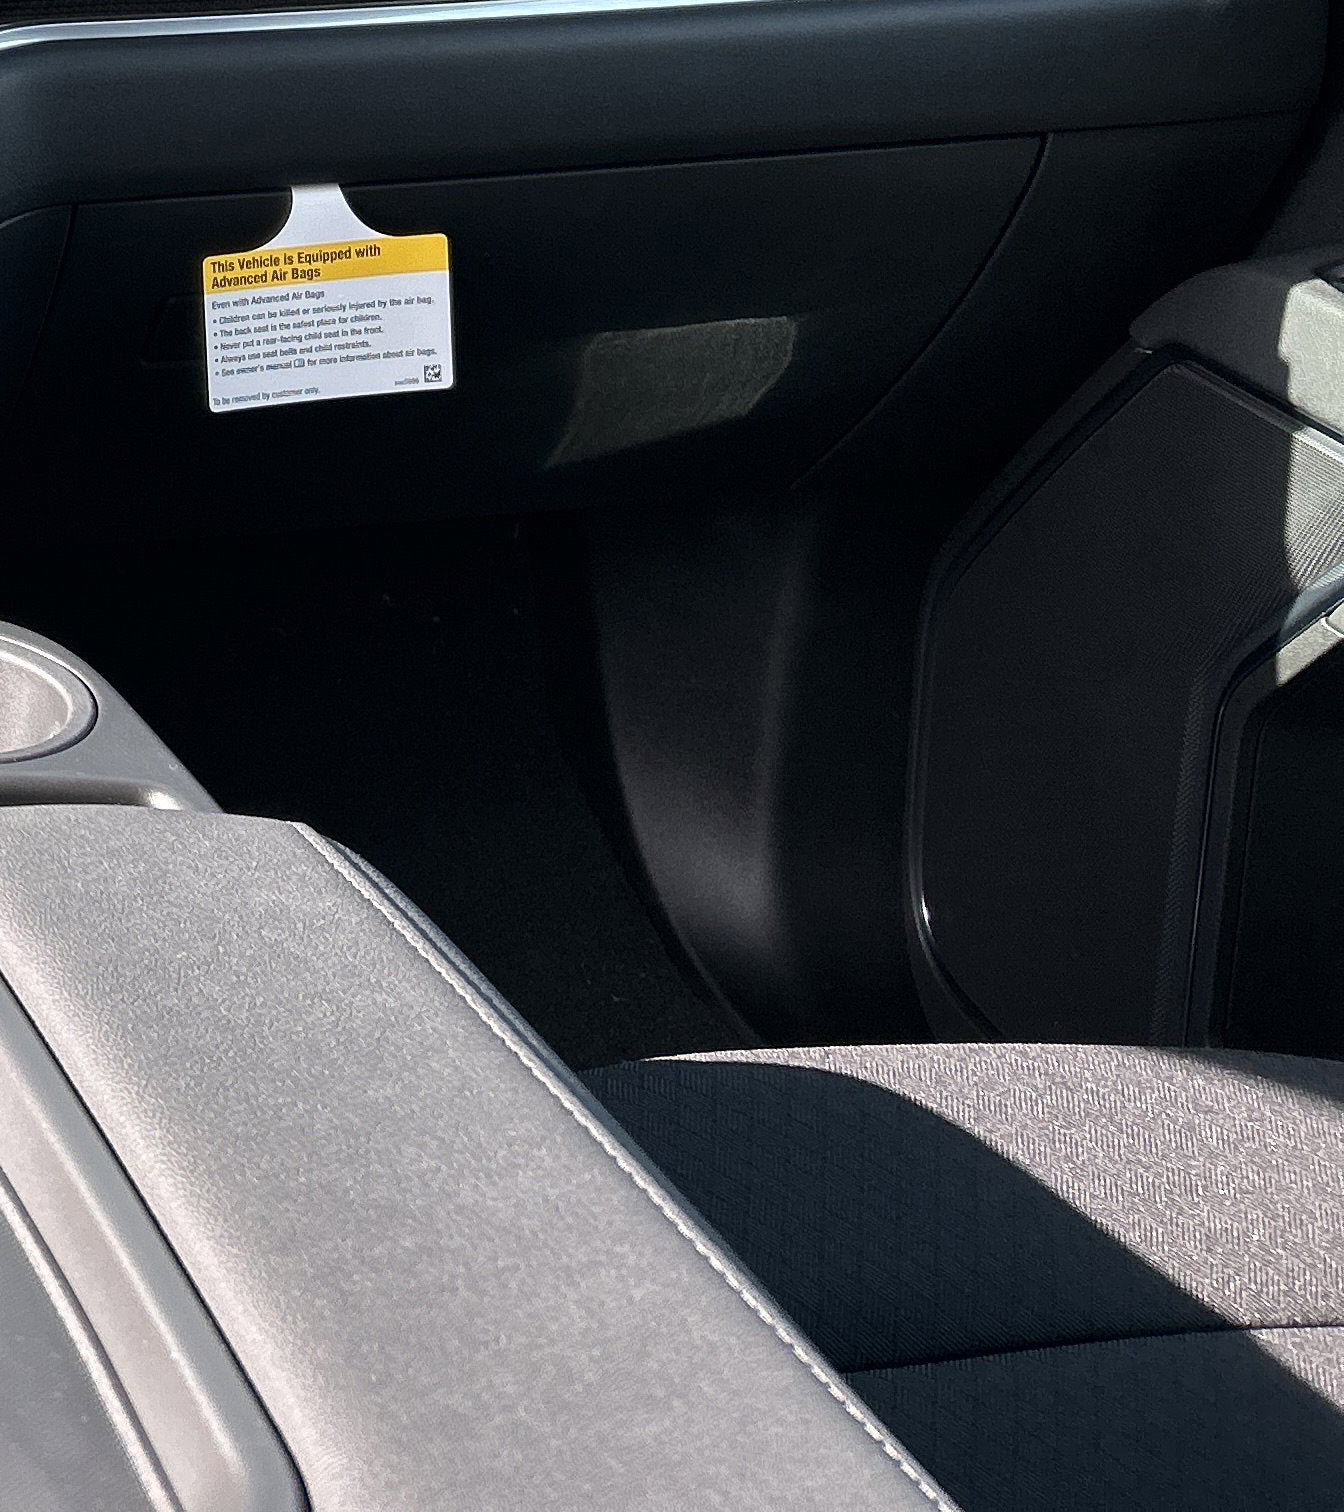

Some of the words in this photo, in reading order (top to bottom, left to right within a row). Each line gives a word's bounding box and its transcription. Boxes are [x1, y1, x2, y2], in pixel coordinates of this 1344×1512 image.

[210, 260, 235, 273] This
[238, 255, 280, 270] Vehicle
[284, 253, 294, 265] is
[297, 246, 352, 266] Equipped
[354, 244, 381, 258] with
[211, 270, 268, 289] Advanced
[271, 268, 289, 282] Air
[291, 267, 321, 281] Bags
[211, 301, 231, 310] Even
[232, 298, 249, 307] with
[251, 293, 290, 305] Advanced
[291, 291, 302, 301] Air
[304, 290, 325, 300] Bags
[219, 315, 250, 325] Children
[279, 308, 300, 317] killed
[312, 302, 347, 313] seriously
[349, 300, 375, 311] injured
[377, 299, 387, 308] by
[389, 298, 402, 306] the
[404, 296, 415, 305] air
[417, 296, 434, 305] bag.
[234, 327, 252, 335] back
[254, 325, 269, 333] seat
[292, 320, 315, 329] safest
[316, 318, 336, 327] place
[350, 314, 383, 323] children.
[213, 398, 221, 406] To
[222, 397, 231, 405] be
[232, 393, 261, 403] removed
[262, 392, 270, 401] by
[272, 388, 303, 398] customer
[304, 387, 321, 395] only.
